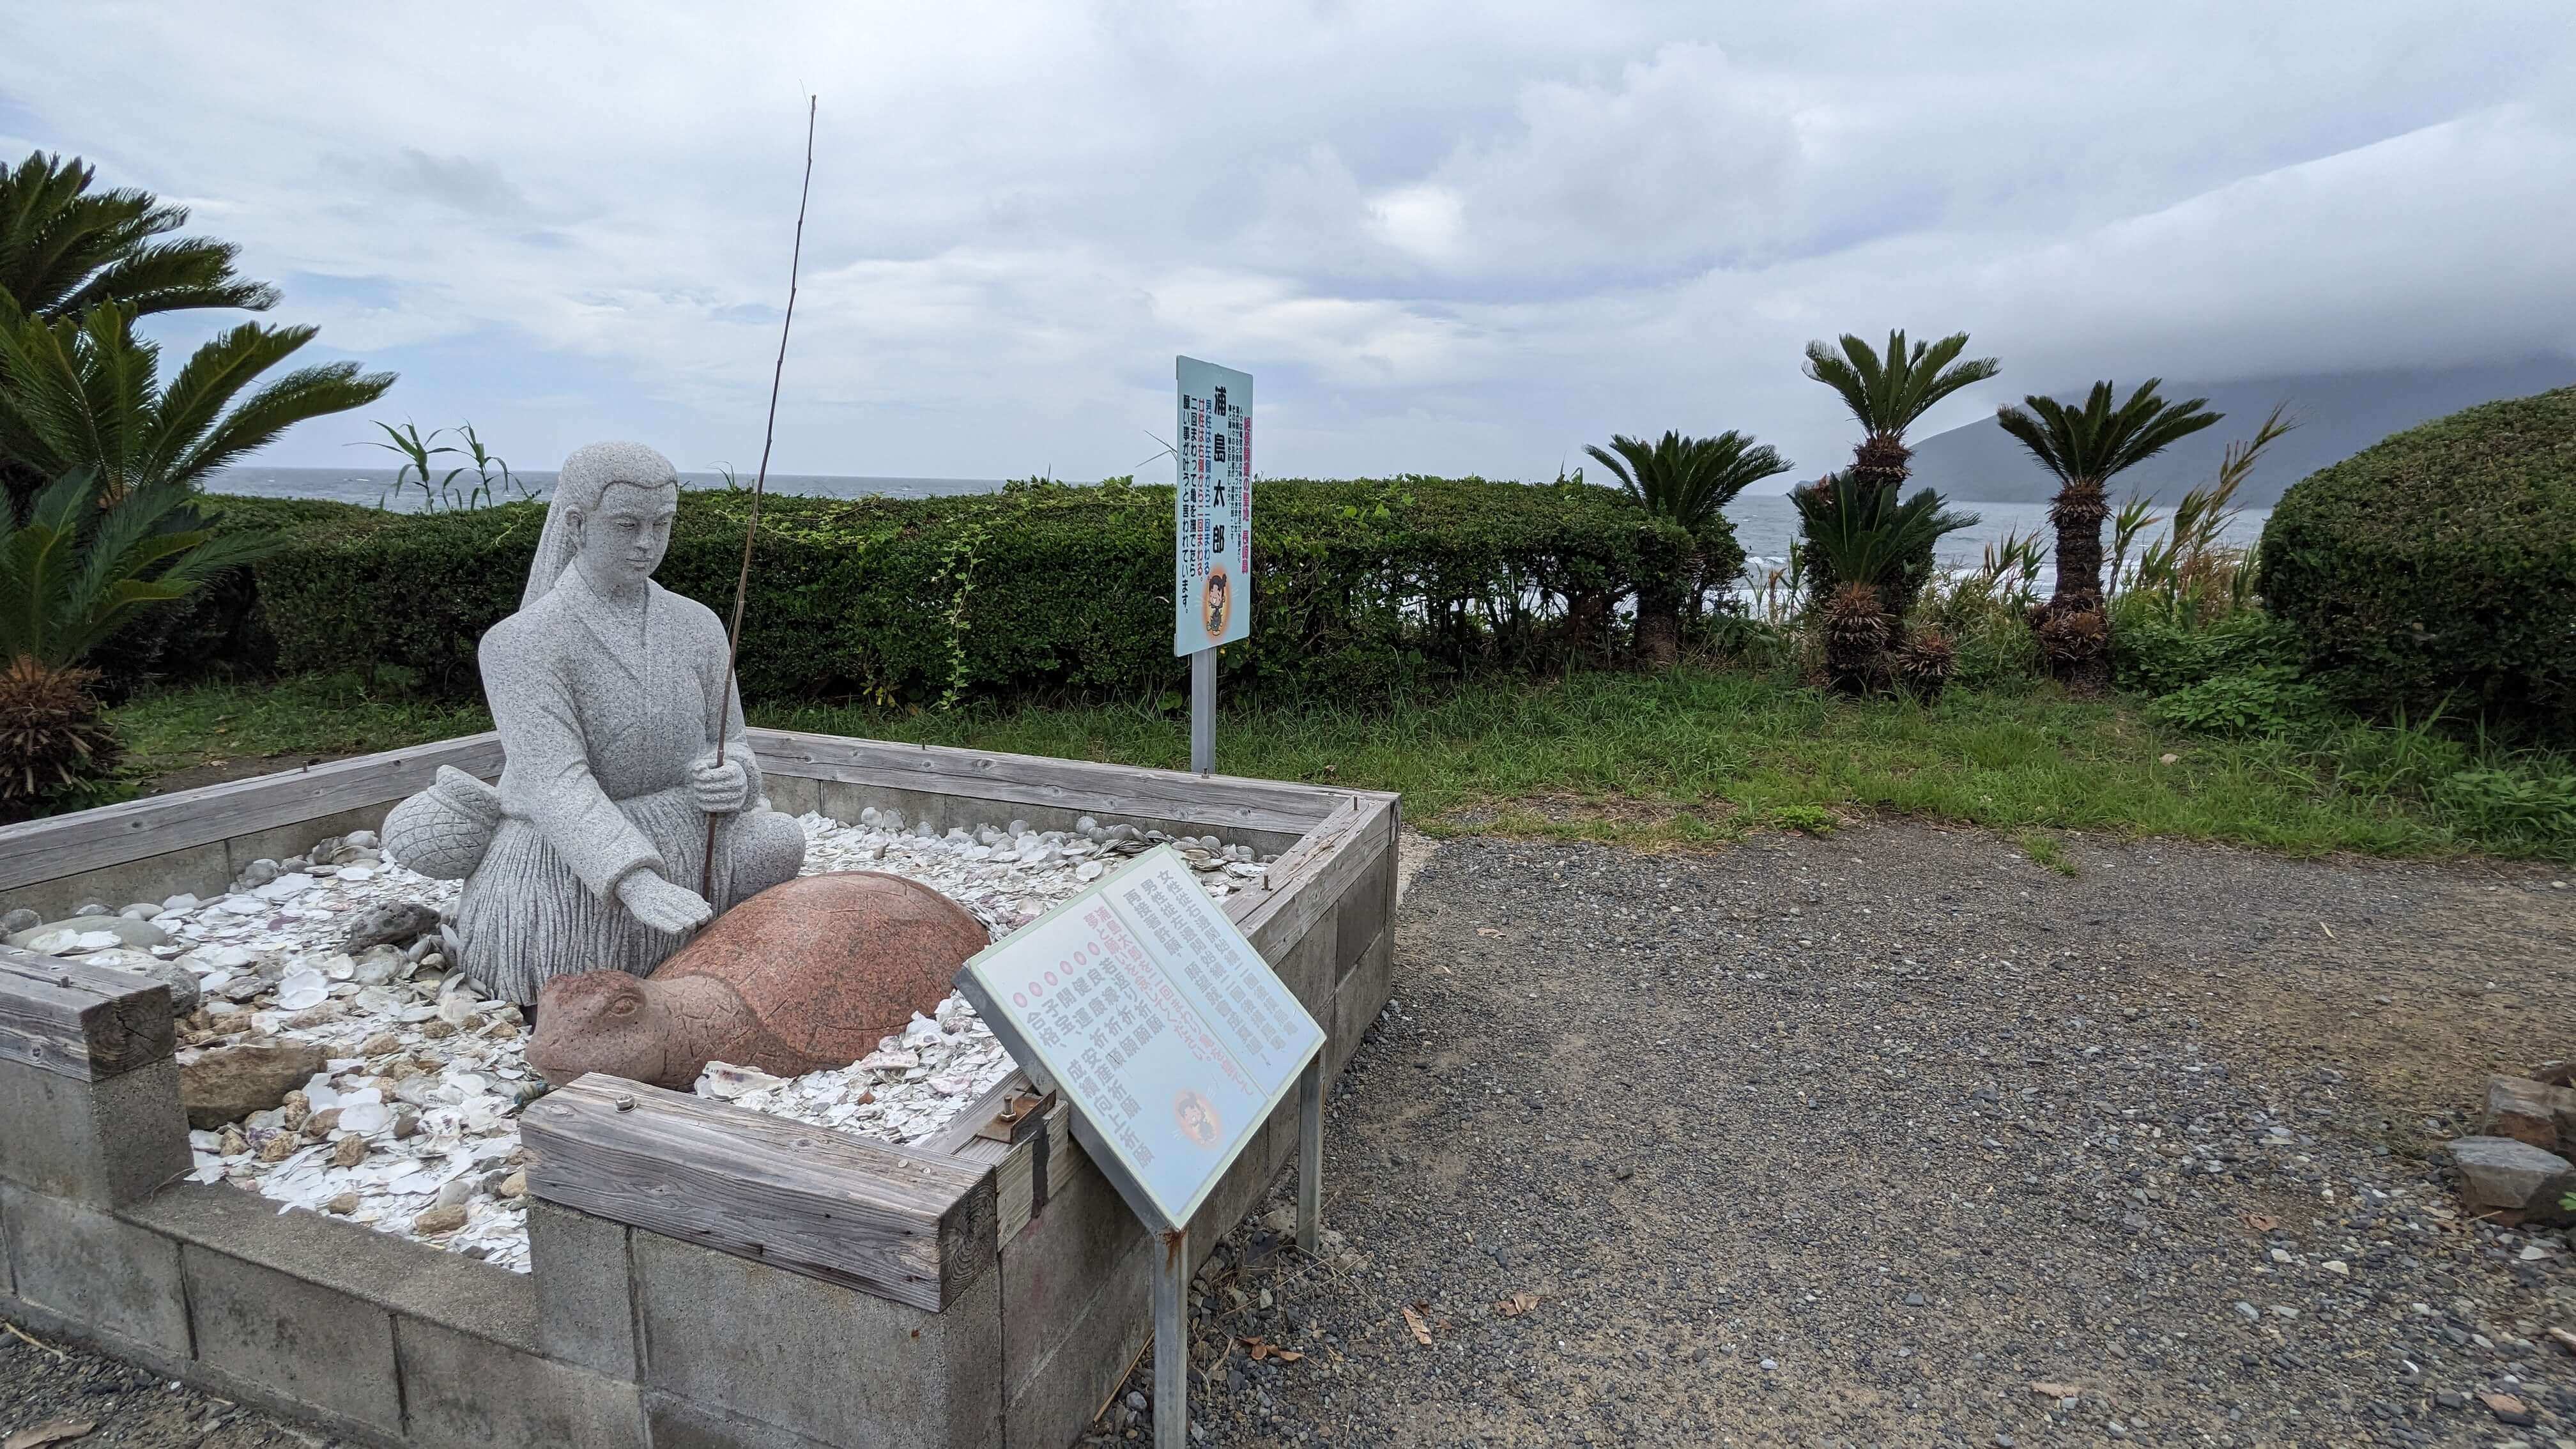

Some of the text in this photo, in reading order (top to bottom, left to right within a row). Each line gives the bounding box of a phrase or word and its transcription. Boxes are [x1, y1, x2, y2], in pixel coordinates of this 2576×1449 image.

[1213, 385, 1227, 553] 浦島太郎
[1070, 975, 1142, 1059] 健康祈願
[1097, 956, 1167, 1036] 若返り祈願
